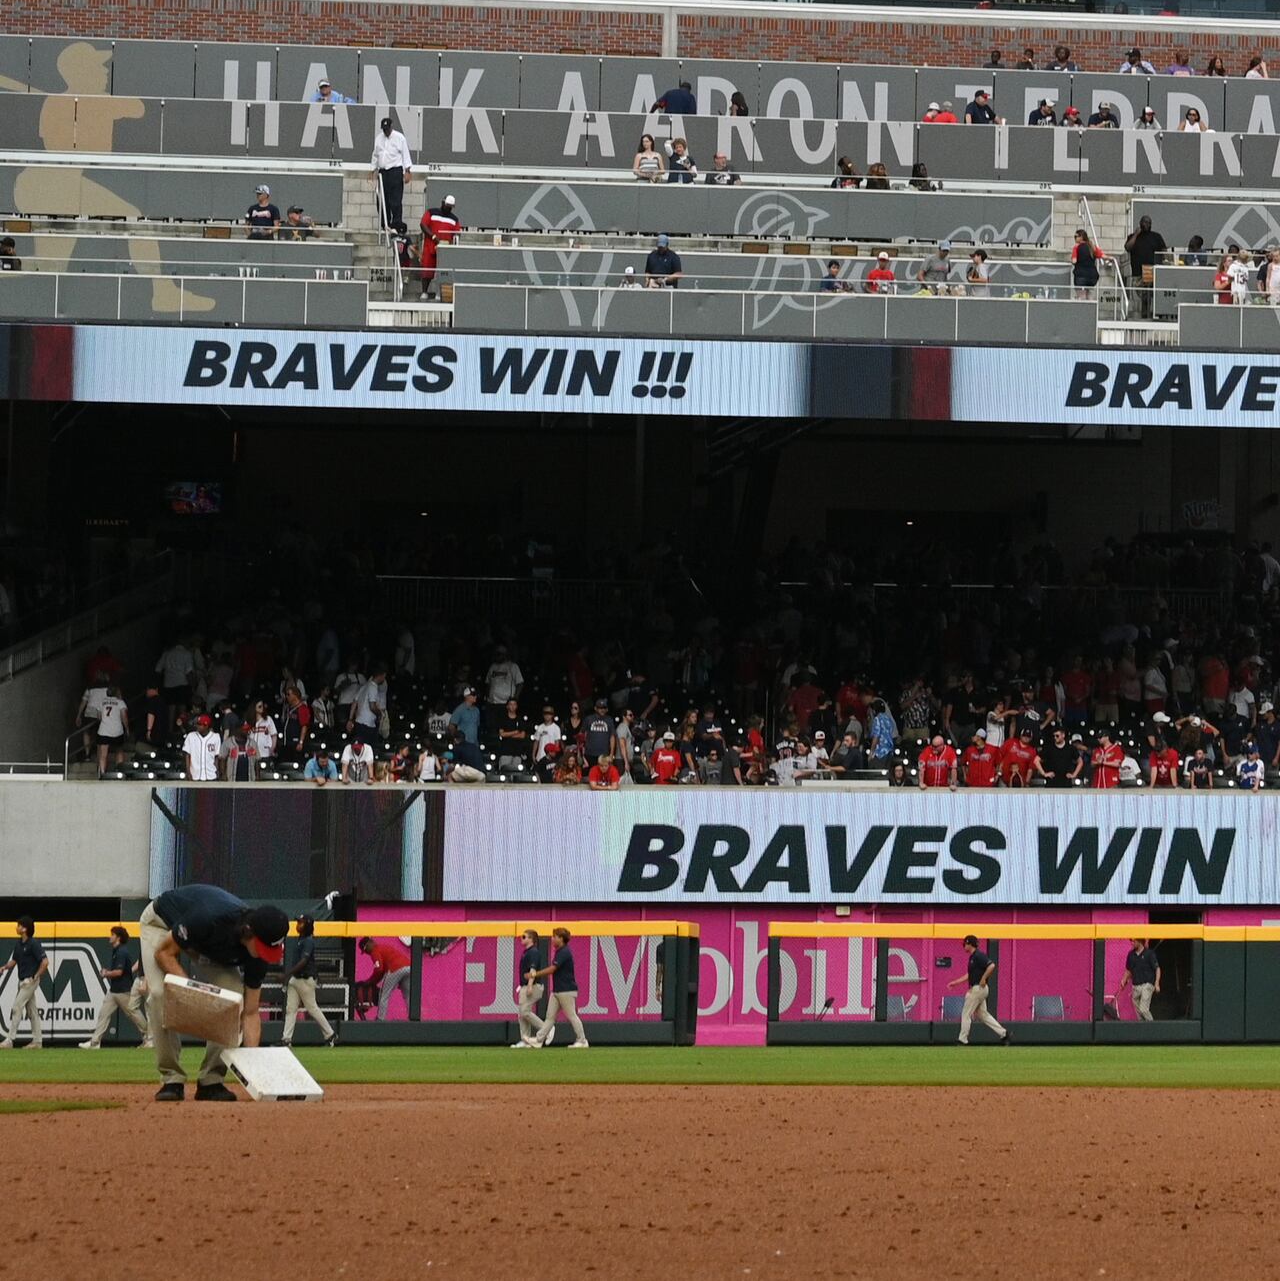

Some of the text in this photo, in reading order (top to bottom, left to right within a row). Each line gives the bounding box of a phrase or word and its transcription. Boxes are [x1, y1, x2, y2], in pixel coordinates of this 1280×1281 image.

[223, 59, 500, 155] HANK
[556, 70, 917, 166] AARON
[182, 339, 458, 395] BRAVES
[477, 347, 622, 398] WIN
[616, 822, 1236, 896] BRAVES WIN
[9, 1007, 95, 1021] RATHON
